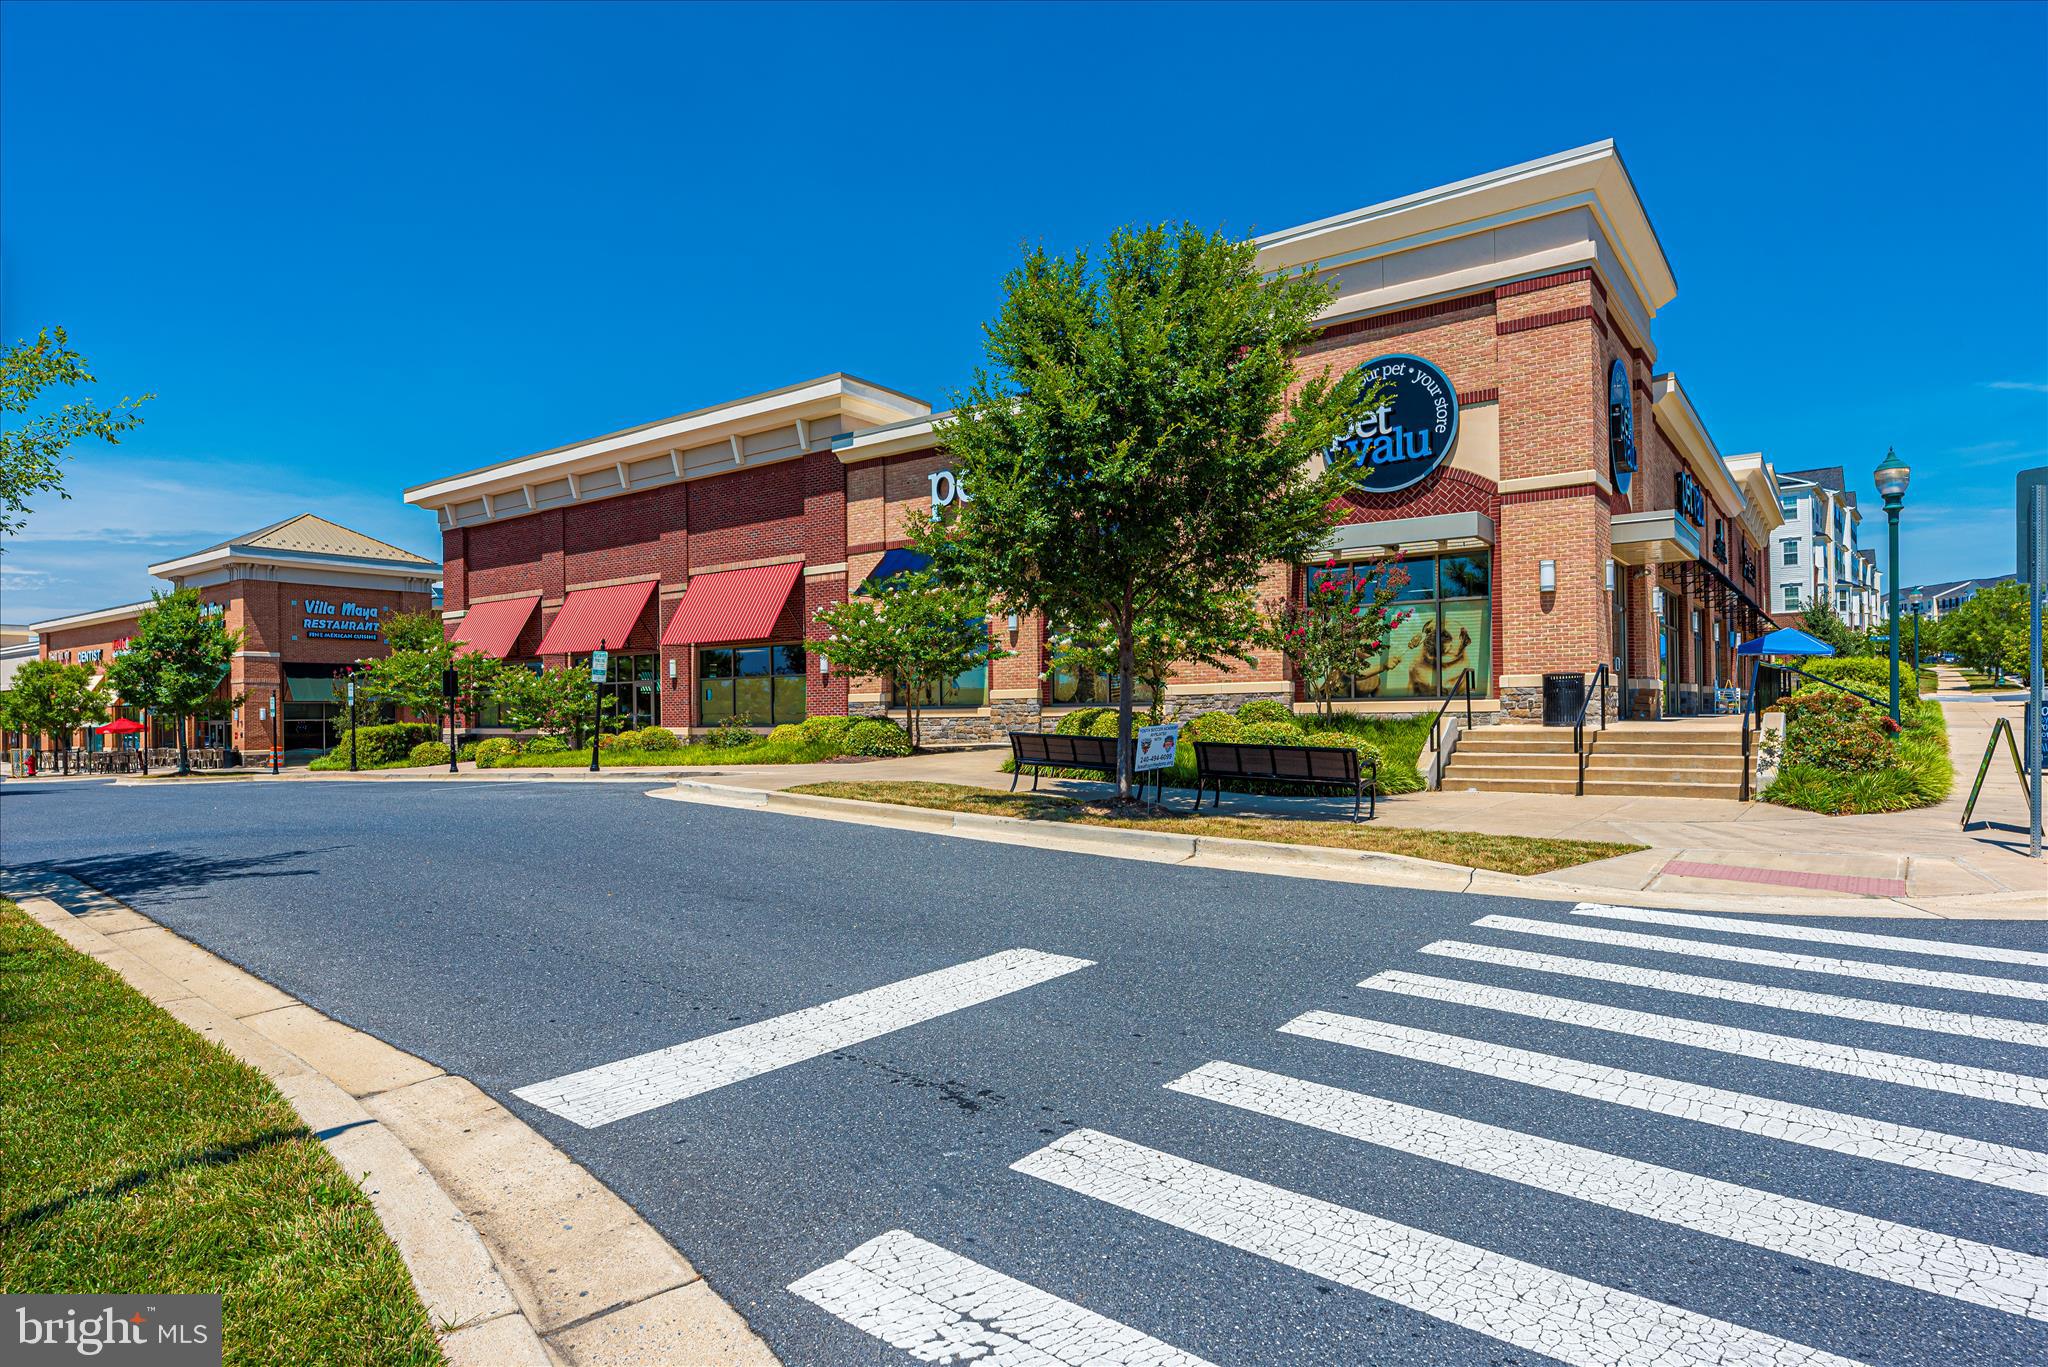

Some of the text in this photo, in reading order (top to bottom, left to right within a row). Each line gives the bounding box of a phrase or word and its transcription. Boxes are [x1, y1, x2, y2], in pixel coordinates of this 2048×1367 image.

[1382, 363, 1406, 379] pet
[1411, 370, 1442, 397] your
[1434, 396, 1449, 434] store
[1329, 402, 1393, 452] pet
[1345, 425, 1433, 467] valu
[303, 618, 380, 631] RESTAURANT
[305, 600, 378, 620] Villa Maya
[78, 649, 102, 662] DENTIST
